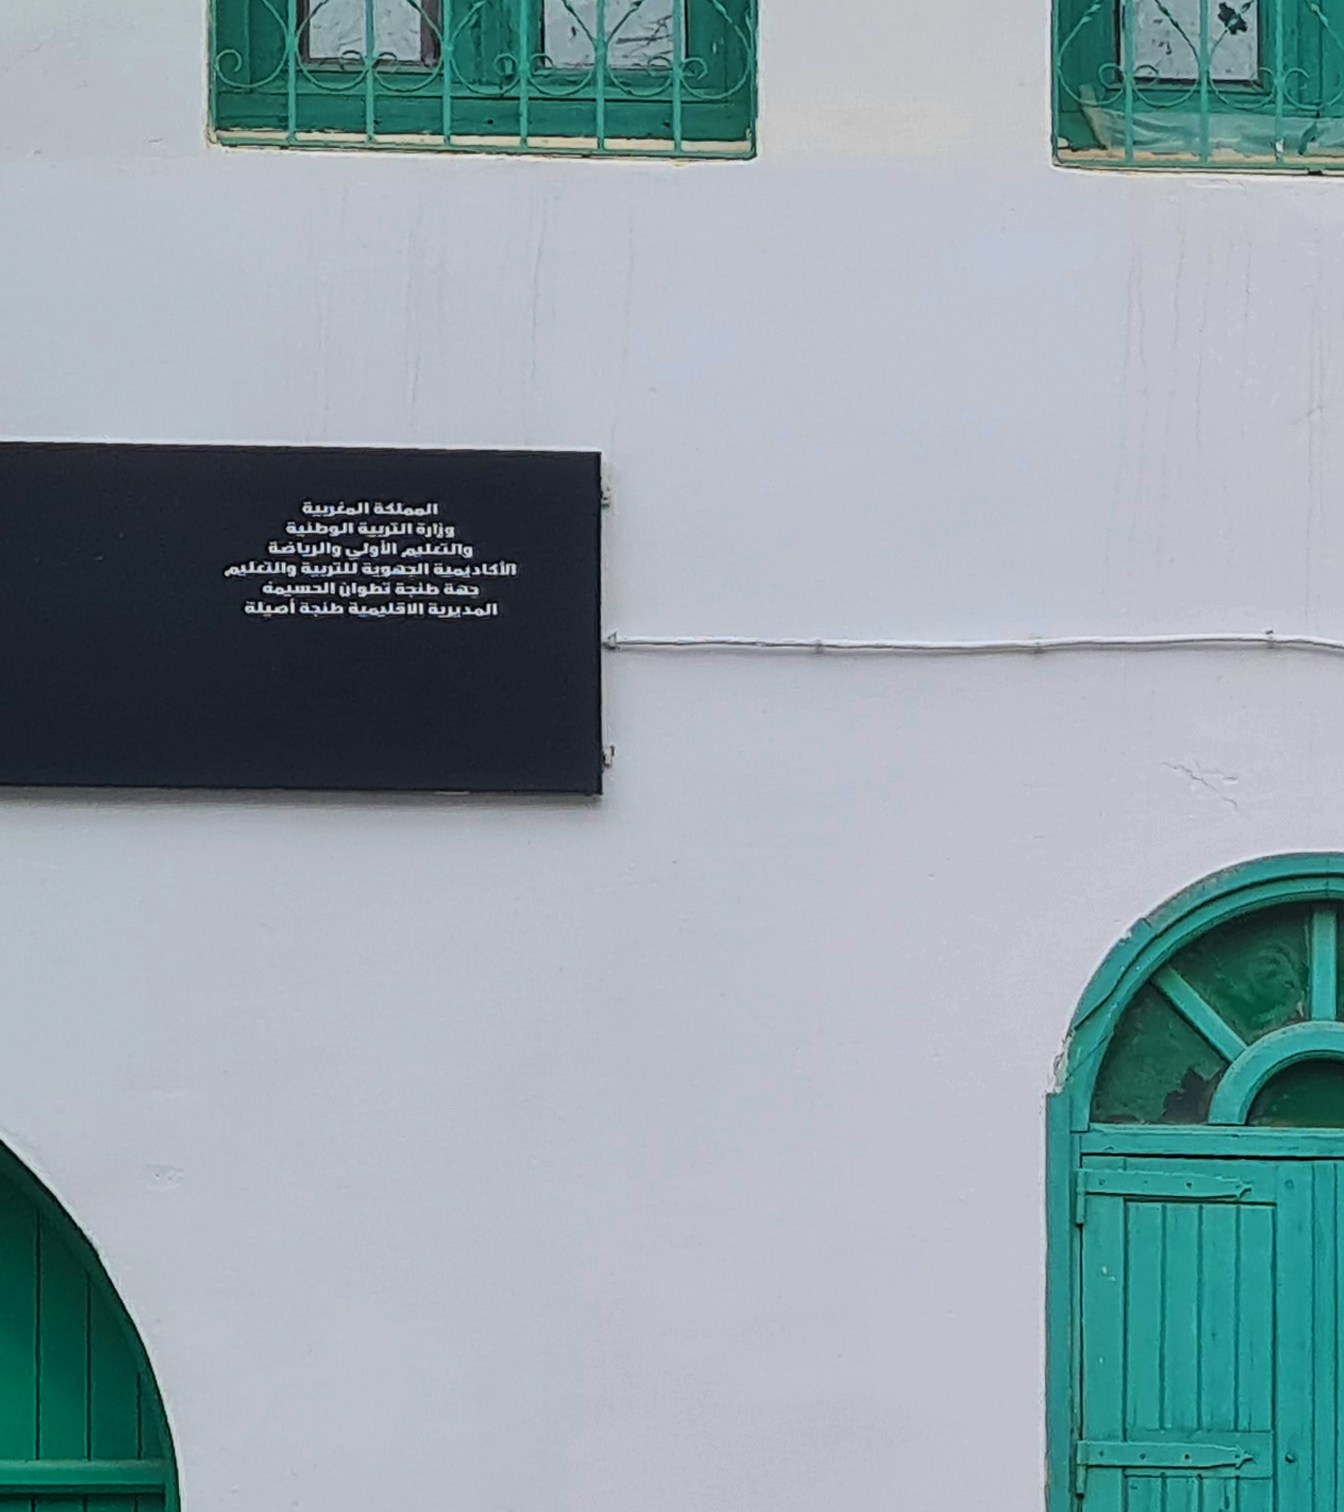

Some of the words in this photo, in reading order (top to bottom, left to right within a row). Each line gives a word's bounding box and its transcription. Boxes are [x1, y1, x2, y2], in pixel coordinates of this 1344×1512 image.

[302, 502, 370, 518] المغربية
[374, 502, 439, 517] المملكة
[286, 522, 355, 538] الوطنية
[358, 522, 413, 538] التربية
[416, 522, 456, 539] وزارة
[268, 541, 342, 558] والرياضة
[401, 542, 474, 559] والتعليم
[225, 561, 297, 578] والتعليم
[301, 562, 358, 578] للتربية
[362, 562, 430, 578] الجهوية
[434, 561, 517, 578] الأكاديمية
[339, 581, 391, 598] تطوان
[395, 582, 441, 598] طنجة
[444, 582, 480, 599] جهة
[245, 600, 296, 617] أصيلة
[299, 602, 345, 618] طنجة
[428, 602, 499, 618] المديرية
